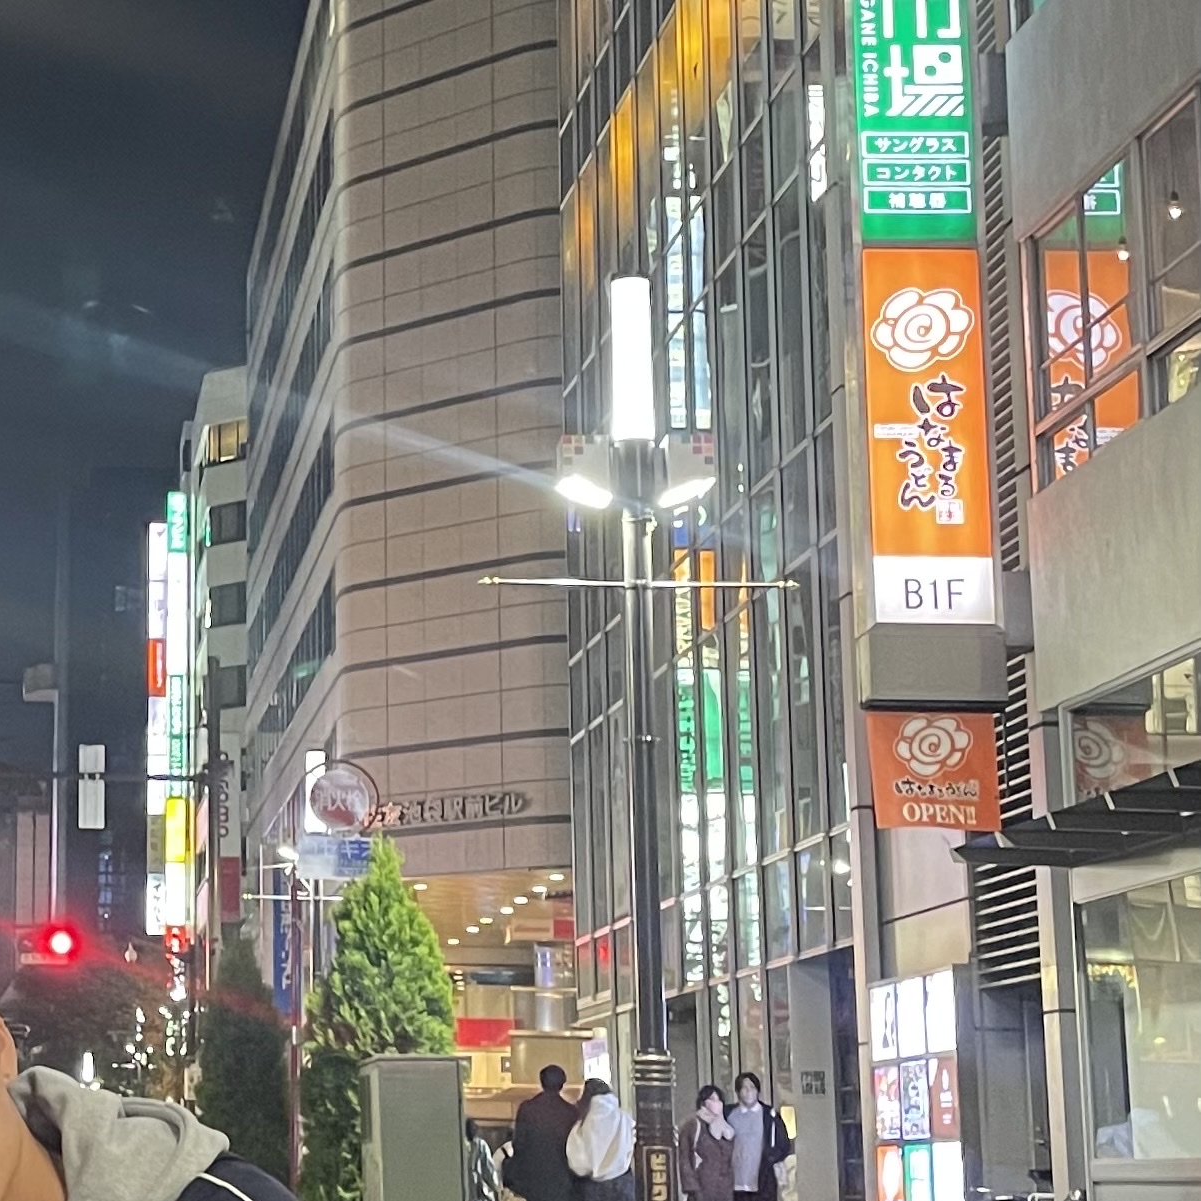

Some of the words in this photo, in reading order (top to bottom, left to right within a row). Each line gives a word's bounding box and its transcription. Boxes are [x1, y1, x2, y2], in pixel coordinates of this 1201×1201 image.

[862, 52, 880, 117] ICHIBA
[874, 136, 957, 153] サングラス
[875, 164, 957, 181] コンタクト
[904, 578, 965, 610] B1F
[902, 801, 977, 825] OPEN!!
